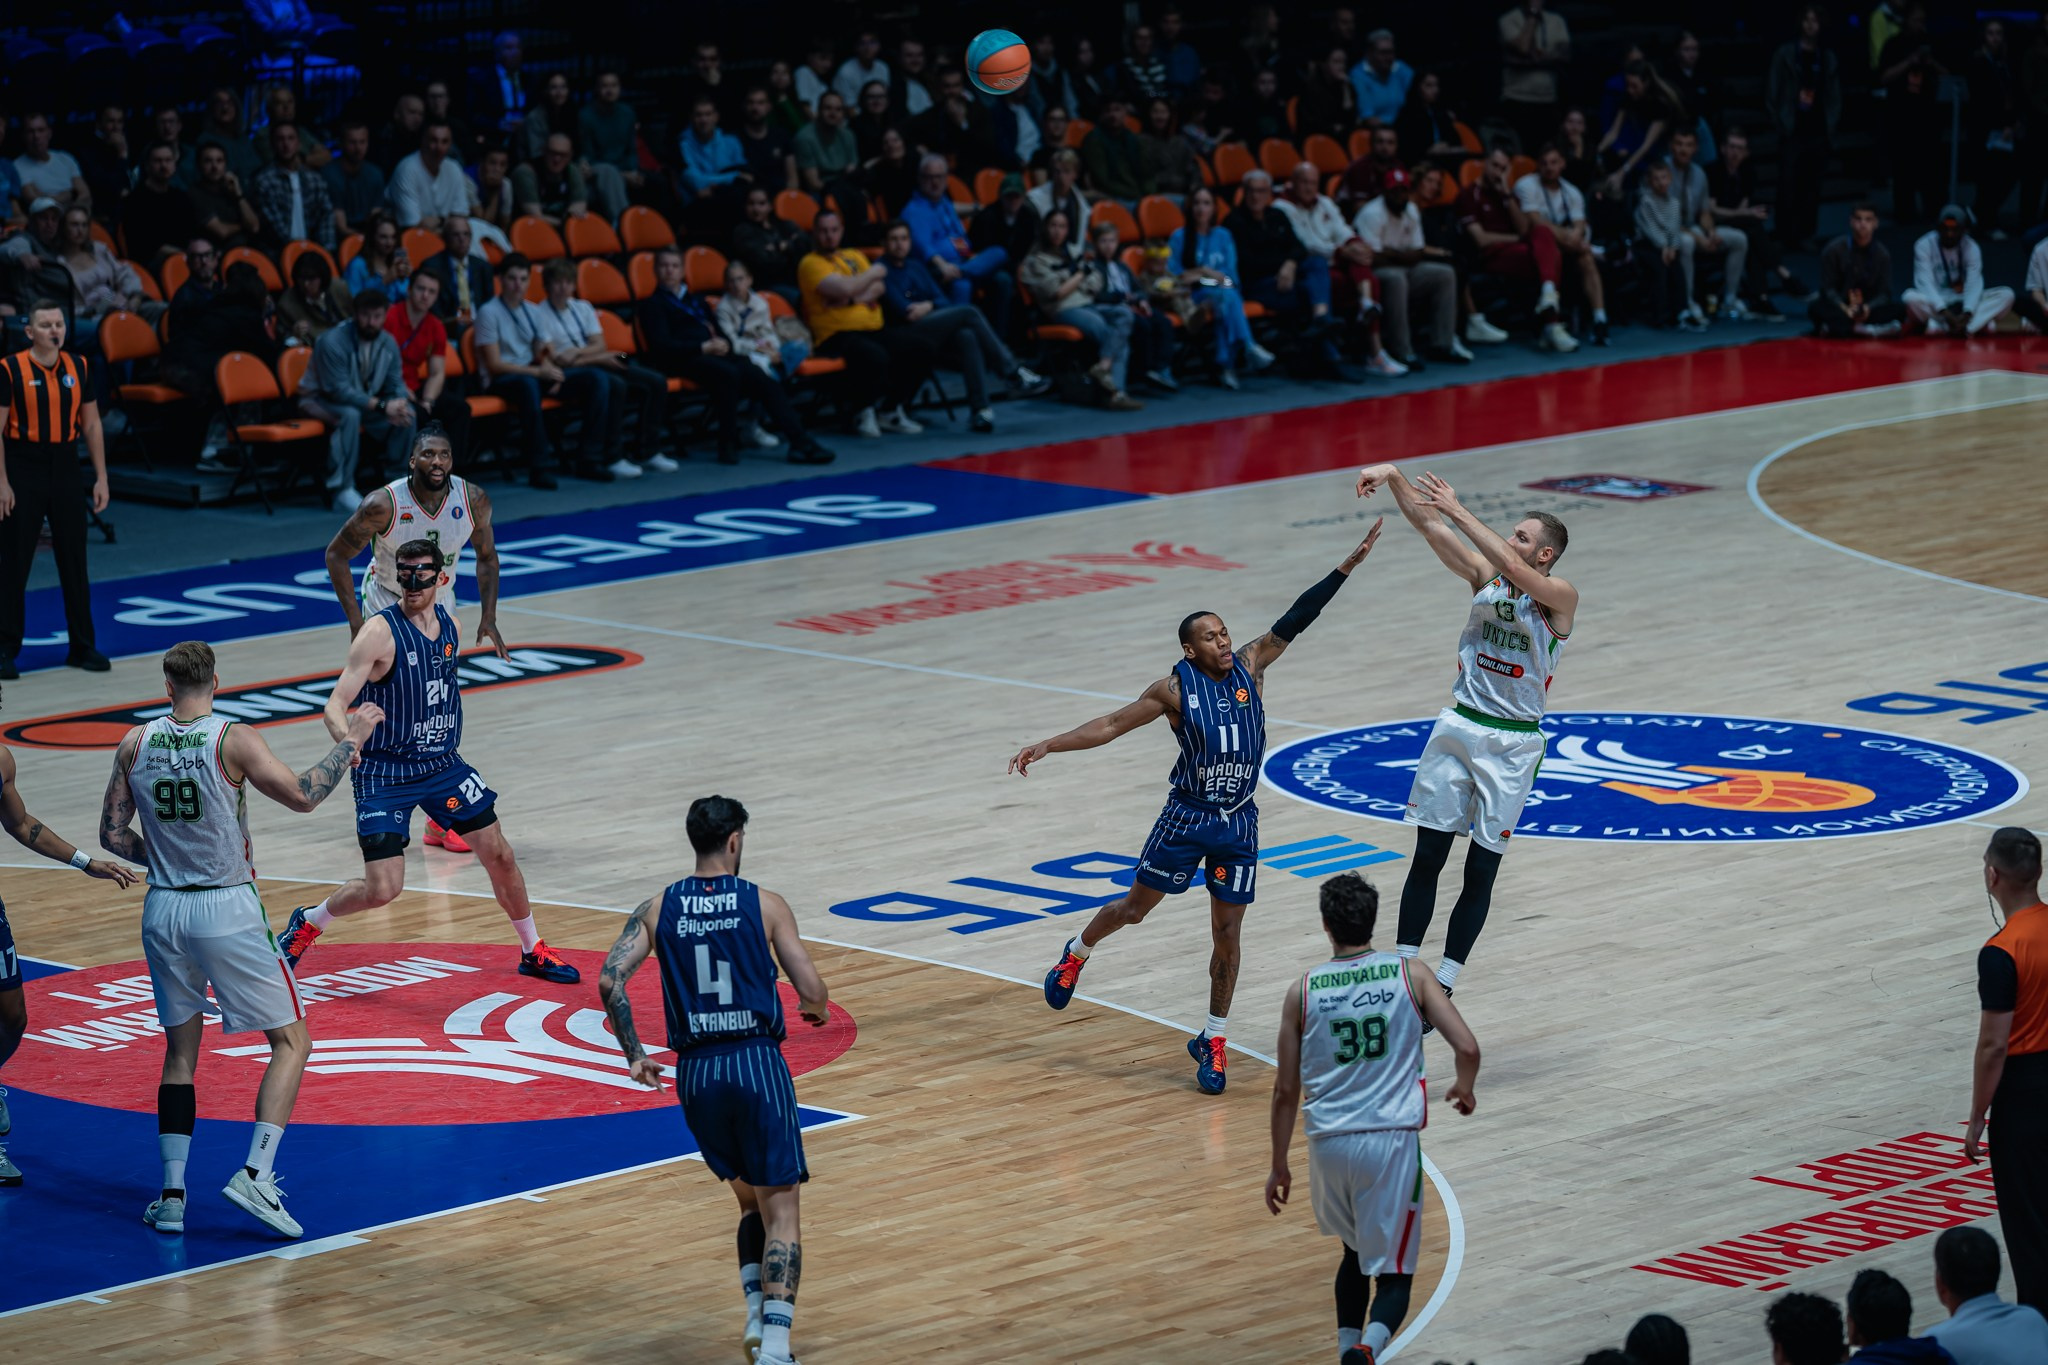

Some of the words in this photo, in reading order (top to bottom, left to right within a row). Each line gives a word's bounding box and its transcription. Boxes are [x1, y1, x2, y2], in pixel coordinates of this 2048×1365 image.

[455, 493, 938, 578] SUPER
[1495, 600, 1516, 625] 13
[1482, 620, 1531, 653] UNICS
[1477, 655, 1513, 675] WINLINE
[134, 648, 596, 723] WIIN
[426, 678, 449, 707] 24
[1218, 723, 1240, 754] 11
[1724, 721, 1793, 735] НА
[1718, 743, 1793, 760] 20
[1198, 762, 1254, 782] ANADOU
[1860, 738, 1988, 803] СУПЕРКУБОК
[153, 778, 204, 823] 99
[1514, 822, 1582, 835] ВТ
[1603, 826, 1756, 838] ЛИГИ
[1773, 801, 1962, 837] ЕДИНОЙ
[1232, 865, 1255, 893] 11
[680, 893, 738, 914] YUSTA
[677, 916, 741, 938] Bilyoner
[0, 945, 17, 980] 17
[694, 943, 733, 1006] 4
[1309, 964, 1400, 991] KONOVALOV
[23, 956, 482, 1052] МОСКИЙ
[1329, 1013, 1389, 1066] 38
[260, 1132, 271, 1151] MAXX
[1630, 1169, 1998, 1292] СКОВСКИЙ
